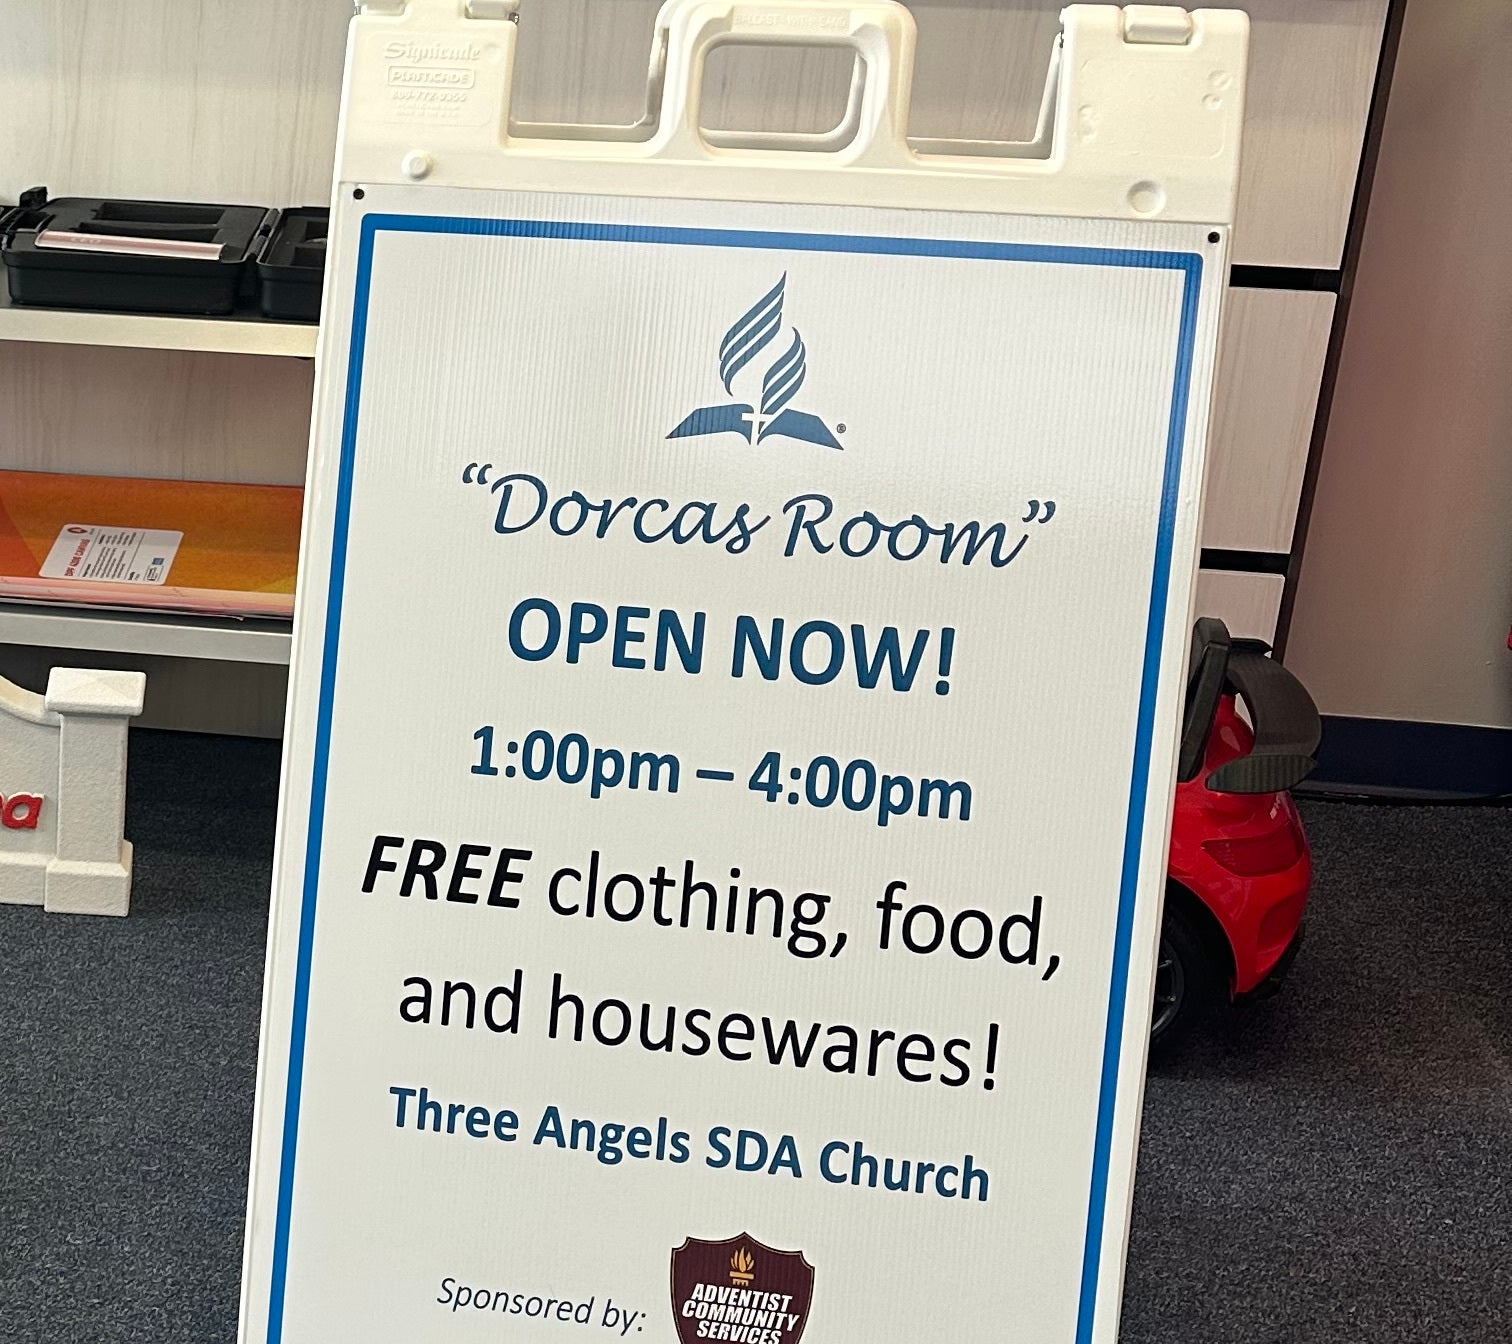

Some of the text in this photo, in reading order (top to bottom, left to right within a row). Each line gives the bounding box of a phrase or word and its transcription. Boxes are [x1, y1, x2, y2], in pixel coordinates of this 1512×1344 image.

[462, 462, 1056, 568] “Dorcas Room”
[508, 597, 956, 696] OPEN NOW!
[470, 725, 680, 800] 1:00pm
[748, 751, 972, 827] 4:00pm
[361, 835, 1060, 981] FREE clothing, food,
[399, 968, 1000, 1091] and housewares!
[389, 1086, 989, 1202] Three Angels SDA Church
[436, 1277, 647, 1337] Sponsored by:
[682, 1299, 799, 1331] COMMUNITY
[691, 1282, 794, 1311] ADVENTIST
